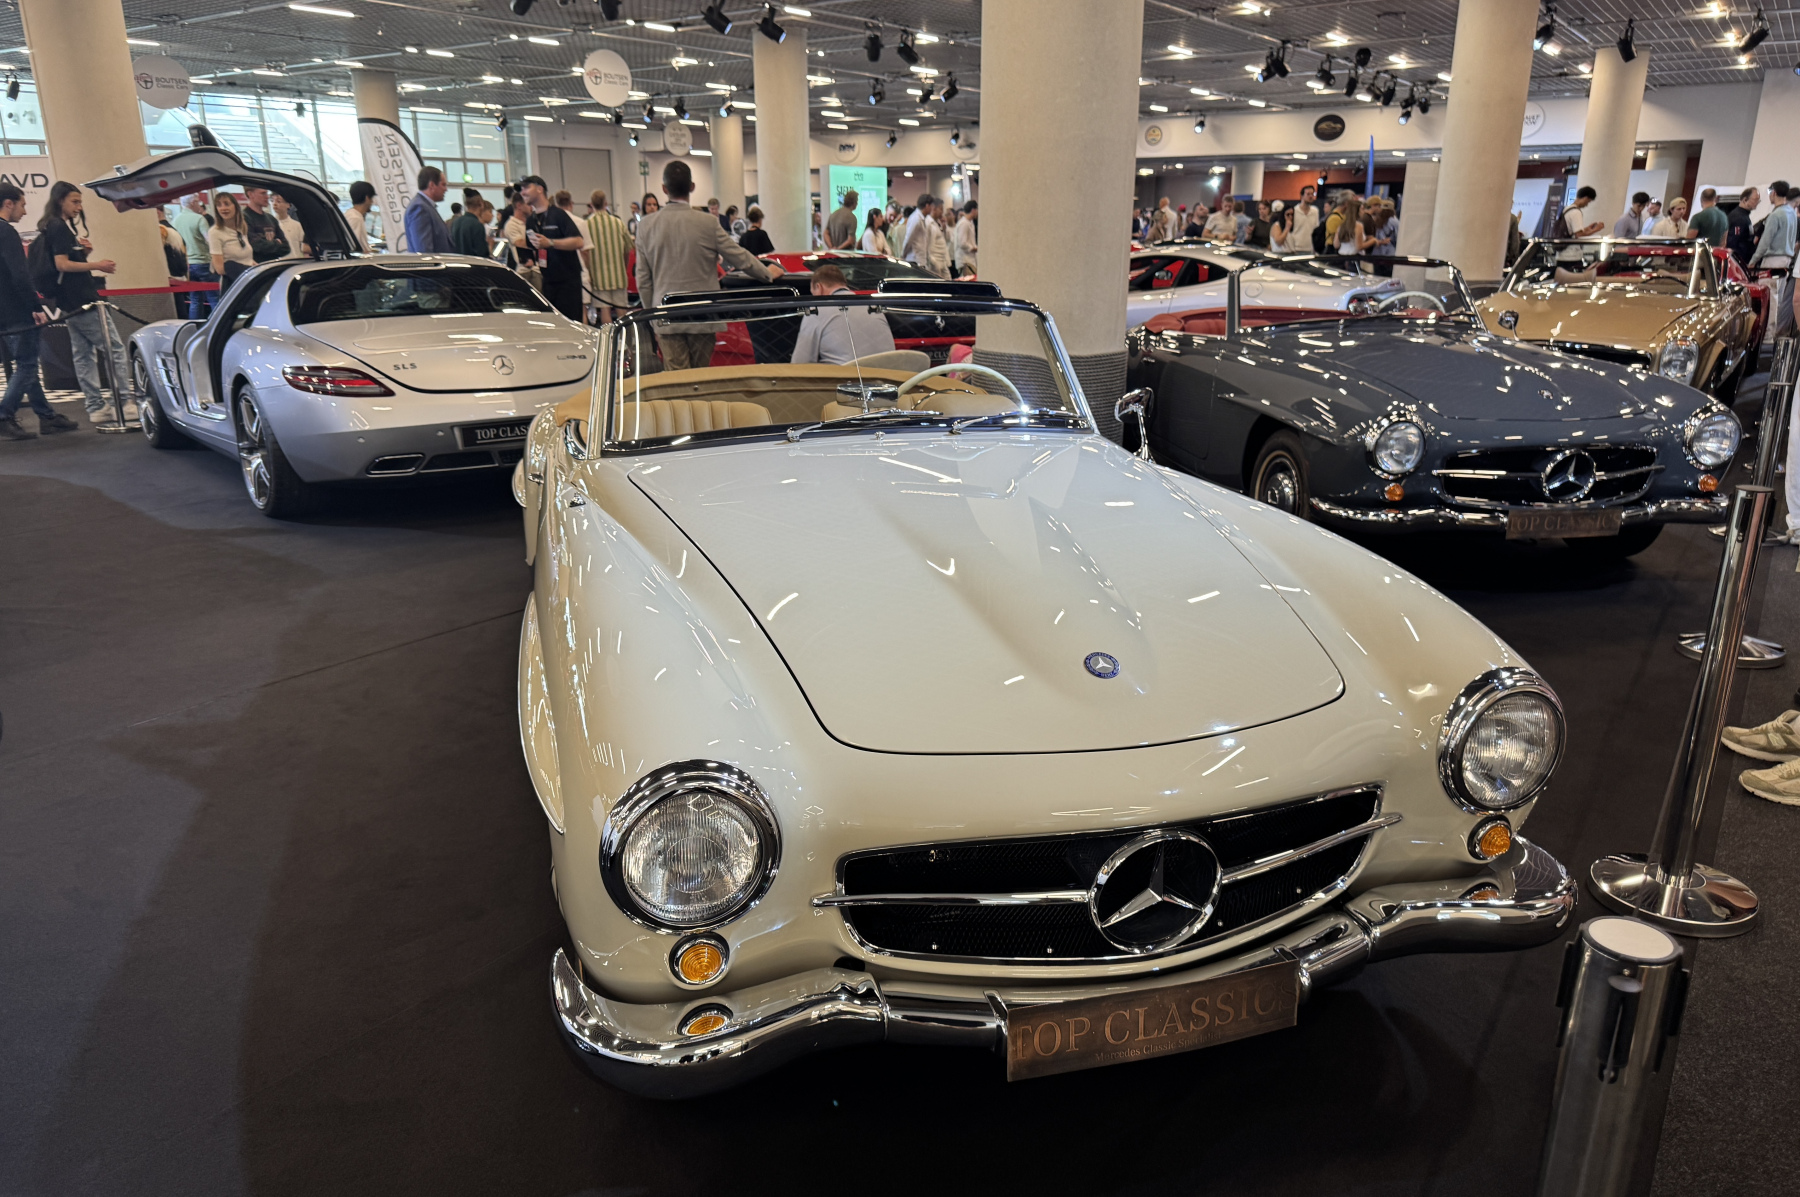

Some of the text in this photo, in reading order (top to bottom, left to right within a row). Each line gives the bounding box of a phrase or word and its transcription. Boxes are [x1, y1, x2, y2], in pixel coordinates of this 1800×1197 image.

[393, 362, 417, 371] SLS
[475, 425, 530, 440] TOP CLAS
[1508, 516, 1540, 531] TOP
[1010, 980, 1296, 1060] TOP CLASSICS
[1095, 1032, 1222, 1062] Mercedes Classic Specialist
